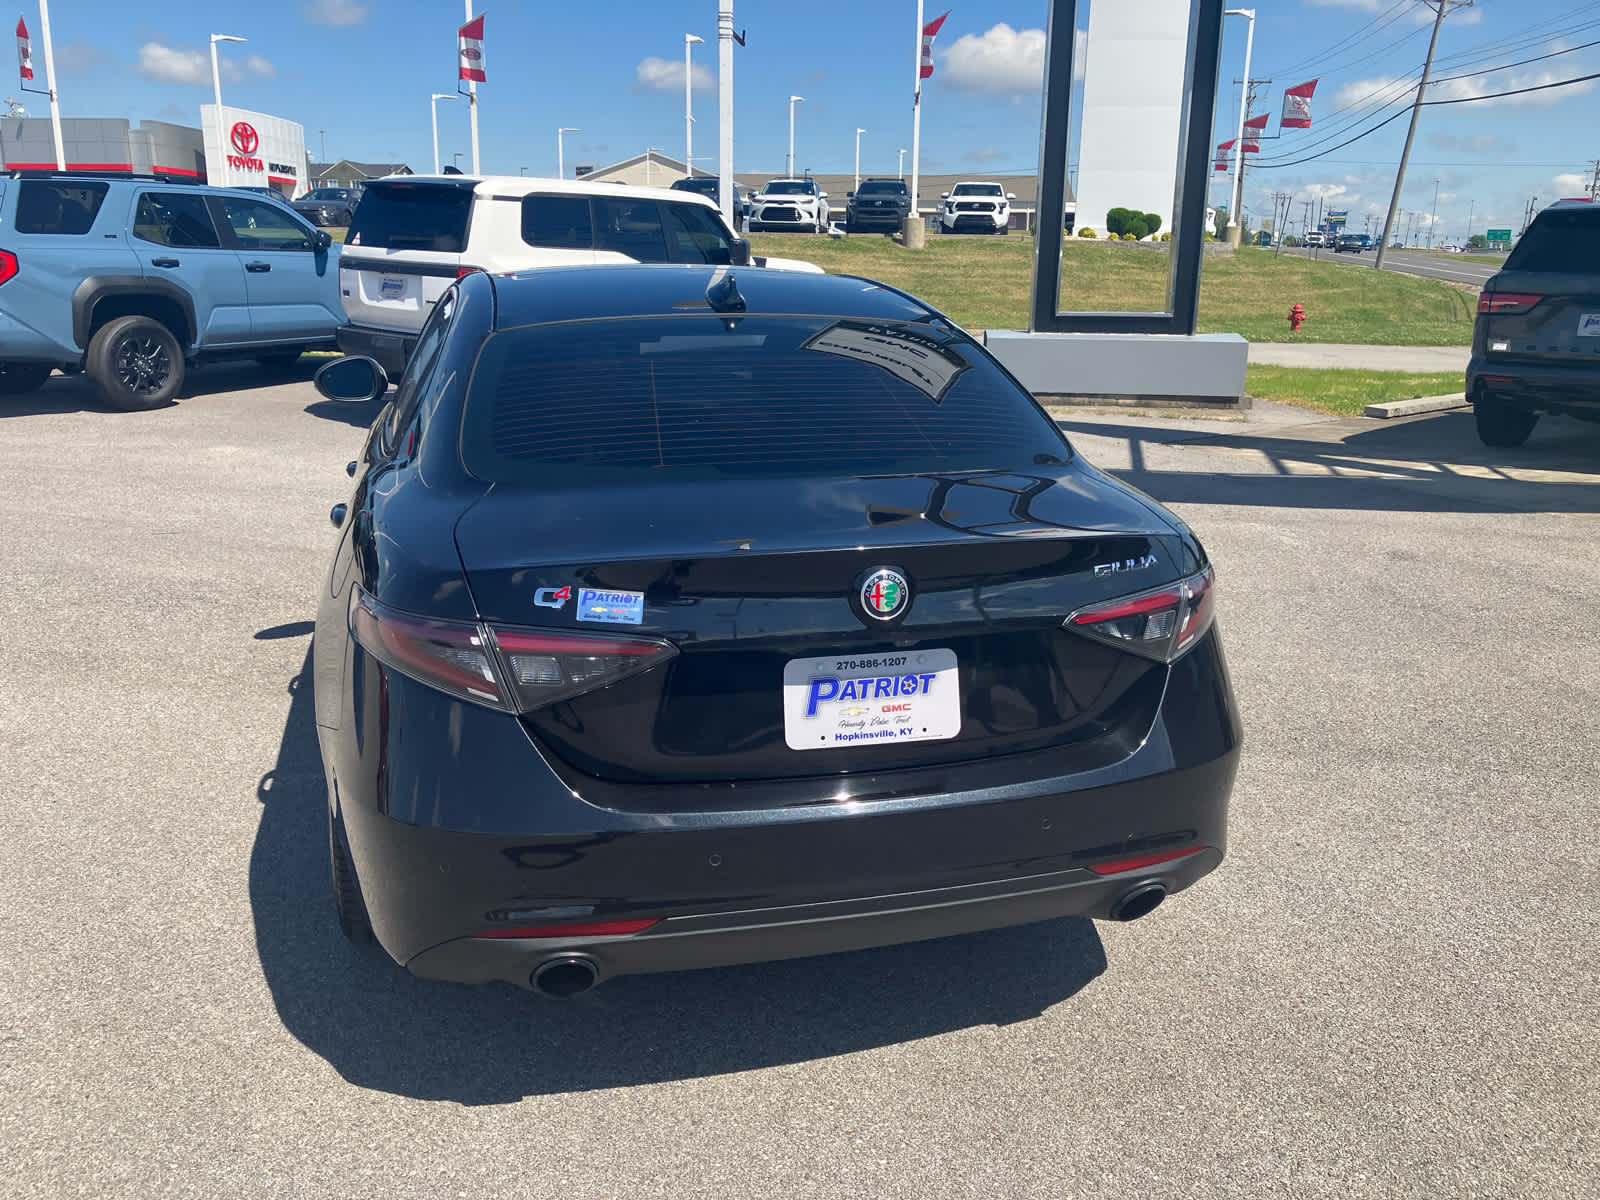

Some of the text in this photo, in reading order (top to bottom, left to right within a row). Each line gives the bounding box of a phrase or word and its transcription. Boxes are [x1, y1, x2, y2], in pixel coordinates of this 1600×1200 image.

[226, 154, 264, 171] TOYOTA
[581, 590, 641, 606] PATRIOT
[836, 657, 907, 670] 270-886-1207
[804, 673, 936, 717] PATRIOT
[881, 703, 912, 713] GMC
[834, 730, 897, 741] Hopkinsville,
[899, 727, 913, 736] KY
